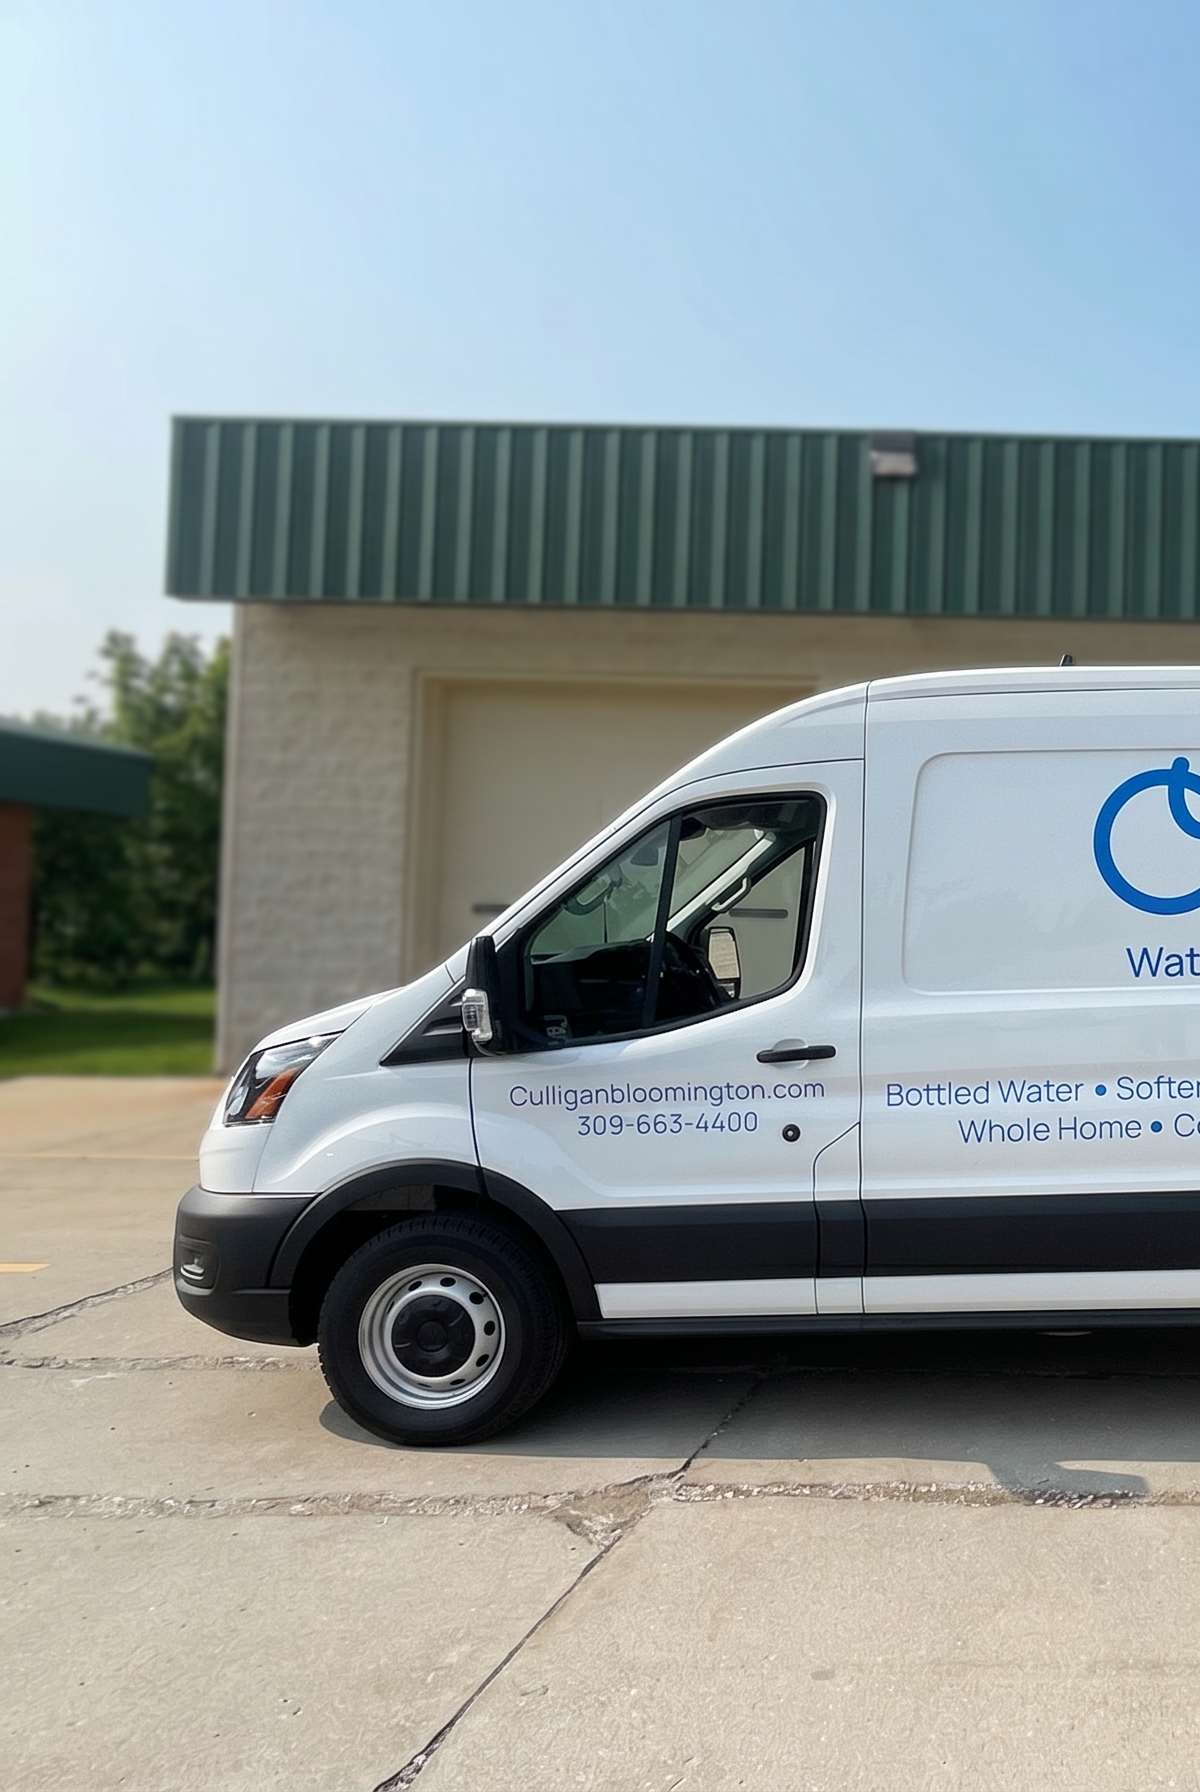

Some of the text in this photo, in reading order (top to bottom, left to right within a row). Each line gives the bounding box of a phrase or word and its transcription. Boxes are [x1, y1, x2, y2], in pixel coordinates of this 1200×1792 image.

[509, 1082, 826, 1111] Culliganbloomington.com
[886, 1082, 991, 1108] Bottled
[997, 1080, 1084, 1105] Water
[577, 1111, 759, 1136] 309-663-4400
[958, 1119, 1051, 1144] Whole
[1058, 1116, 1142, 1141] Home
